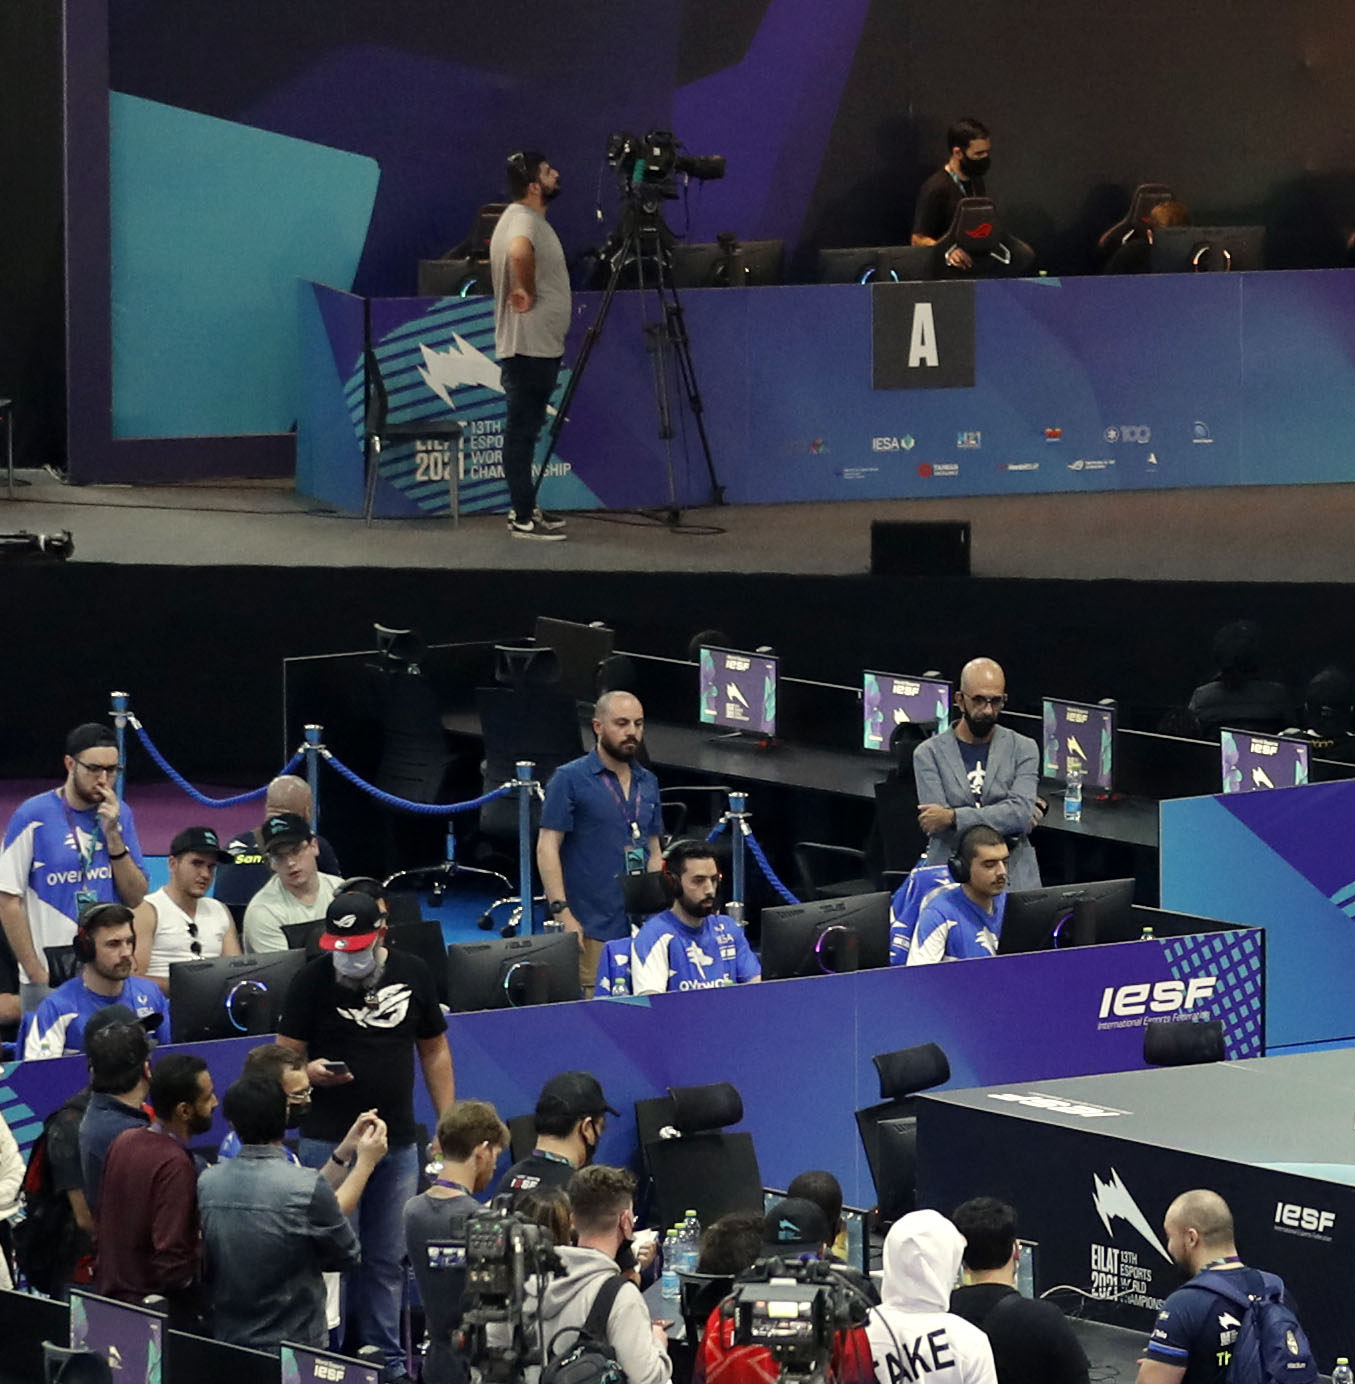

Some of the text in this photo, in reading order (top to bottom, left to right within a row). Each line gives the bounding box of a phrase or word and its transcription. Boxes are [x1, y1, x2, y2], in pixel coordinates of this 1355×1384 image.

[907, 302, 940, 368] A
[470, 434, 504, 449] ESPO
[471, 449, 504, 464] WOR
[1091, 1243, 1120, 1275] EILAT
[1120, 1263, 1153, 1283] ESPORTS
